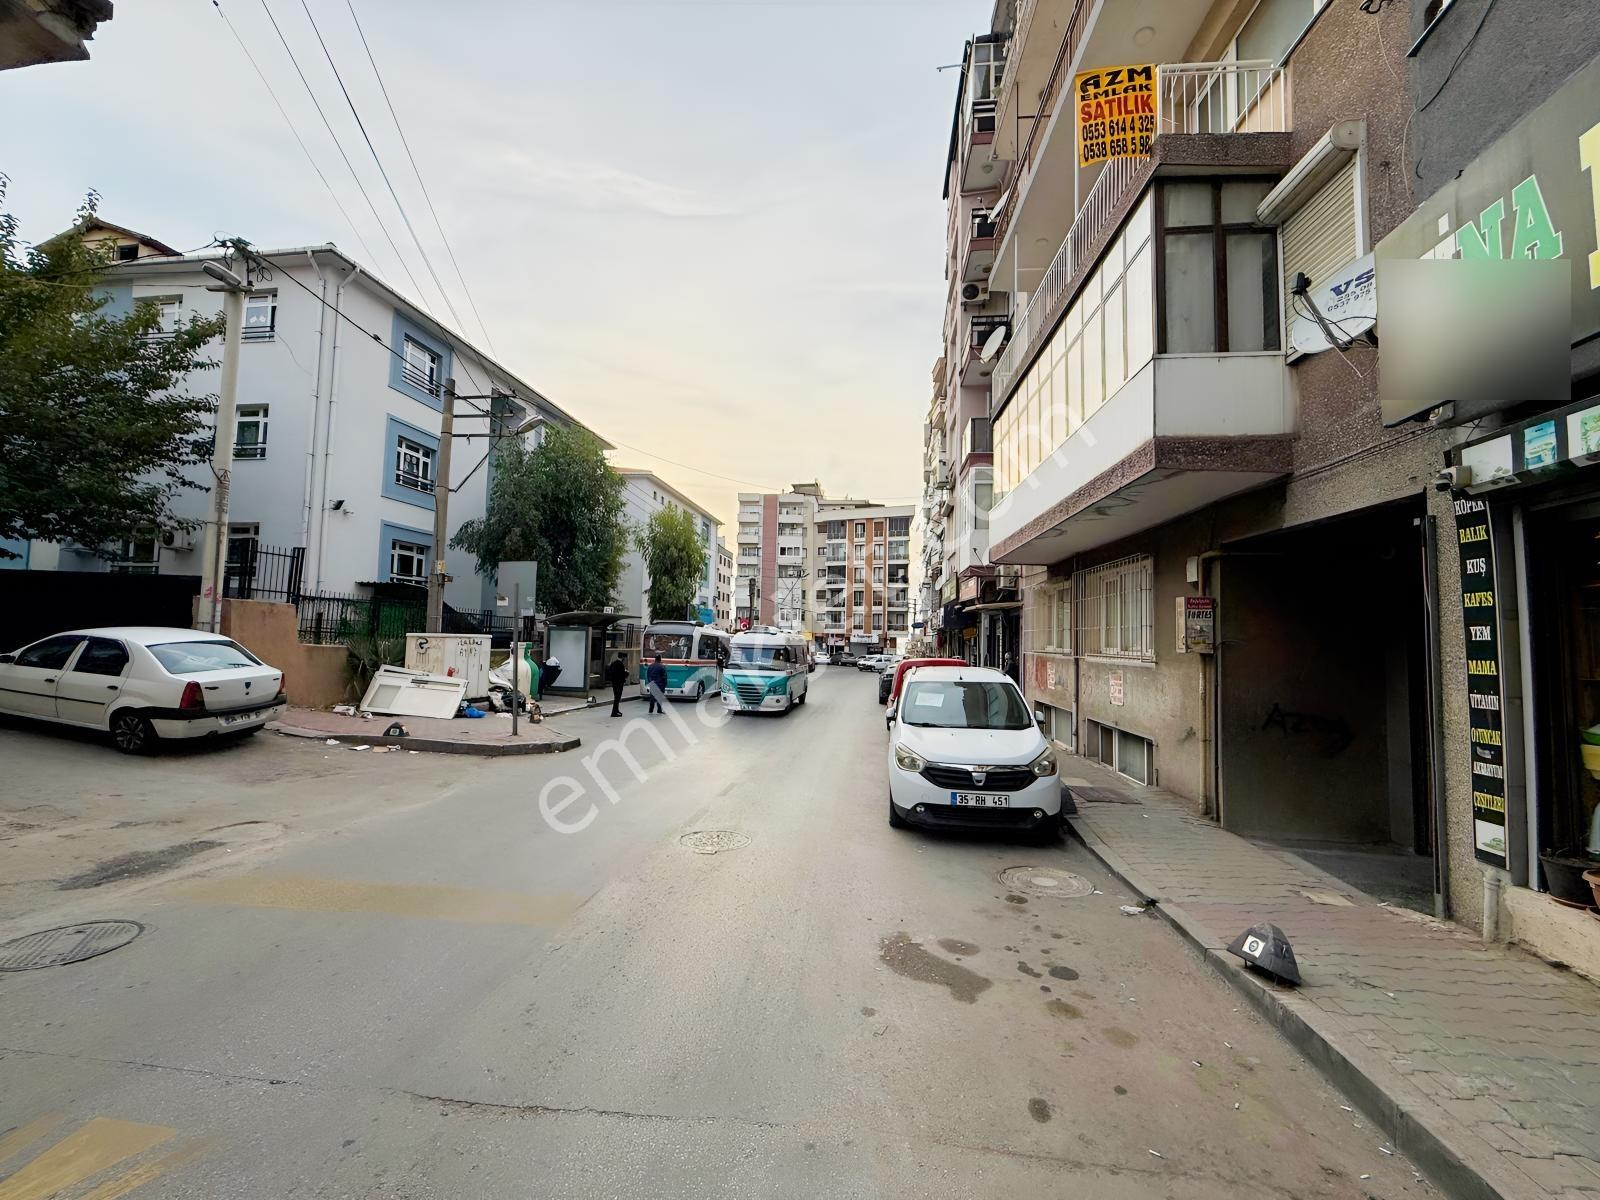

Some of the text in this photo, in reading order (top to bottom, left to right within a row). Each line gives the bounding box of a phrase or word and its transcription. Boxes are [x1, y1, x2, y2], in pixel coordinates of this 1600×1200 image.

[1080, 66, 1152, 93] AZM
[1081, 83, 1152, 102] EMLAK
[1081, 94, 1154, 123] SATILIK
[1082, 121, 1106, 142] 0553
[1109, 116, 1126, 136] 614
[1129, 116, 1135, 134] 4
[1083, 141, 1107, 162] 0538
[1330, 268, 1375, 296] VS
[1459, 525, 1488, 543] BALIK
[1466, 558, 1486, 576] KUŞ
[1463, 591, 1493, 607] KAFES
[1469, 626, 1491, 641] YEM
[1468, 660, 1497, 675] MAMA
[958, 795, 1008, 806] 35 RH 451
